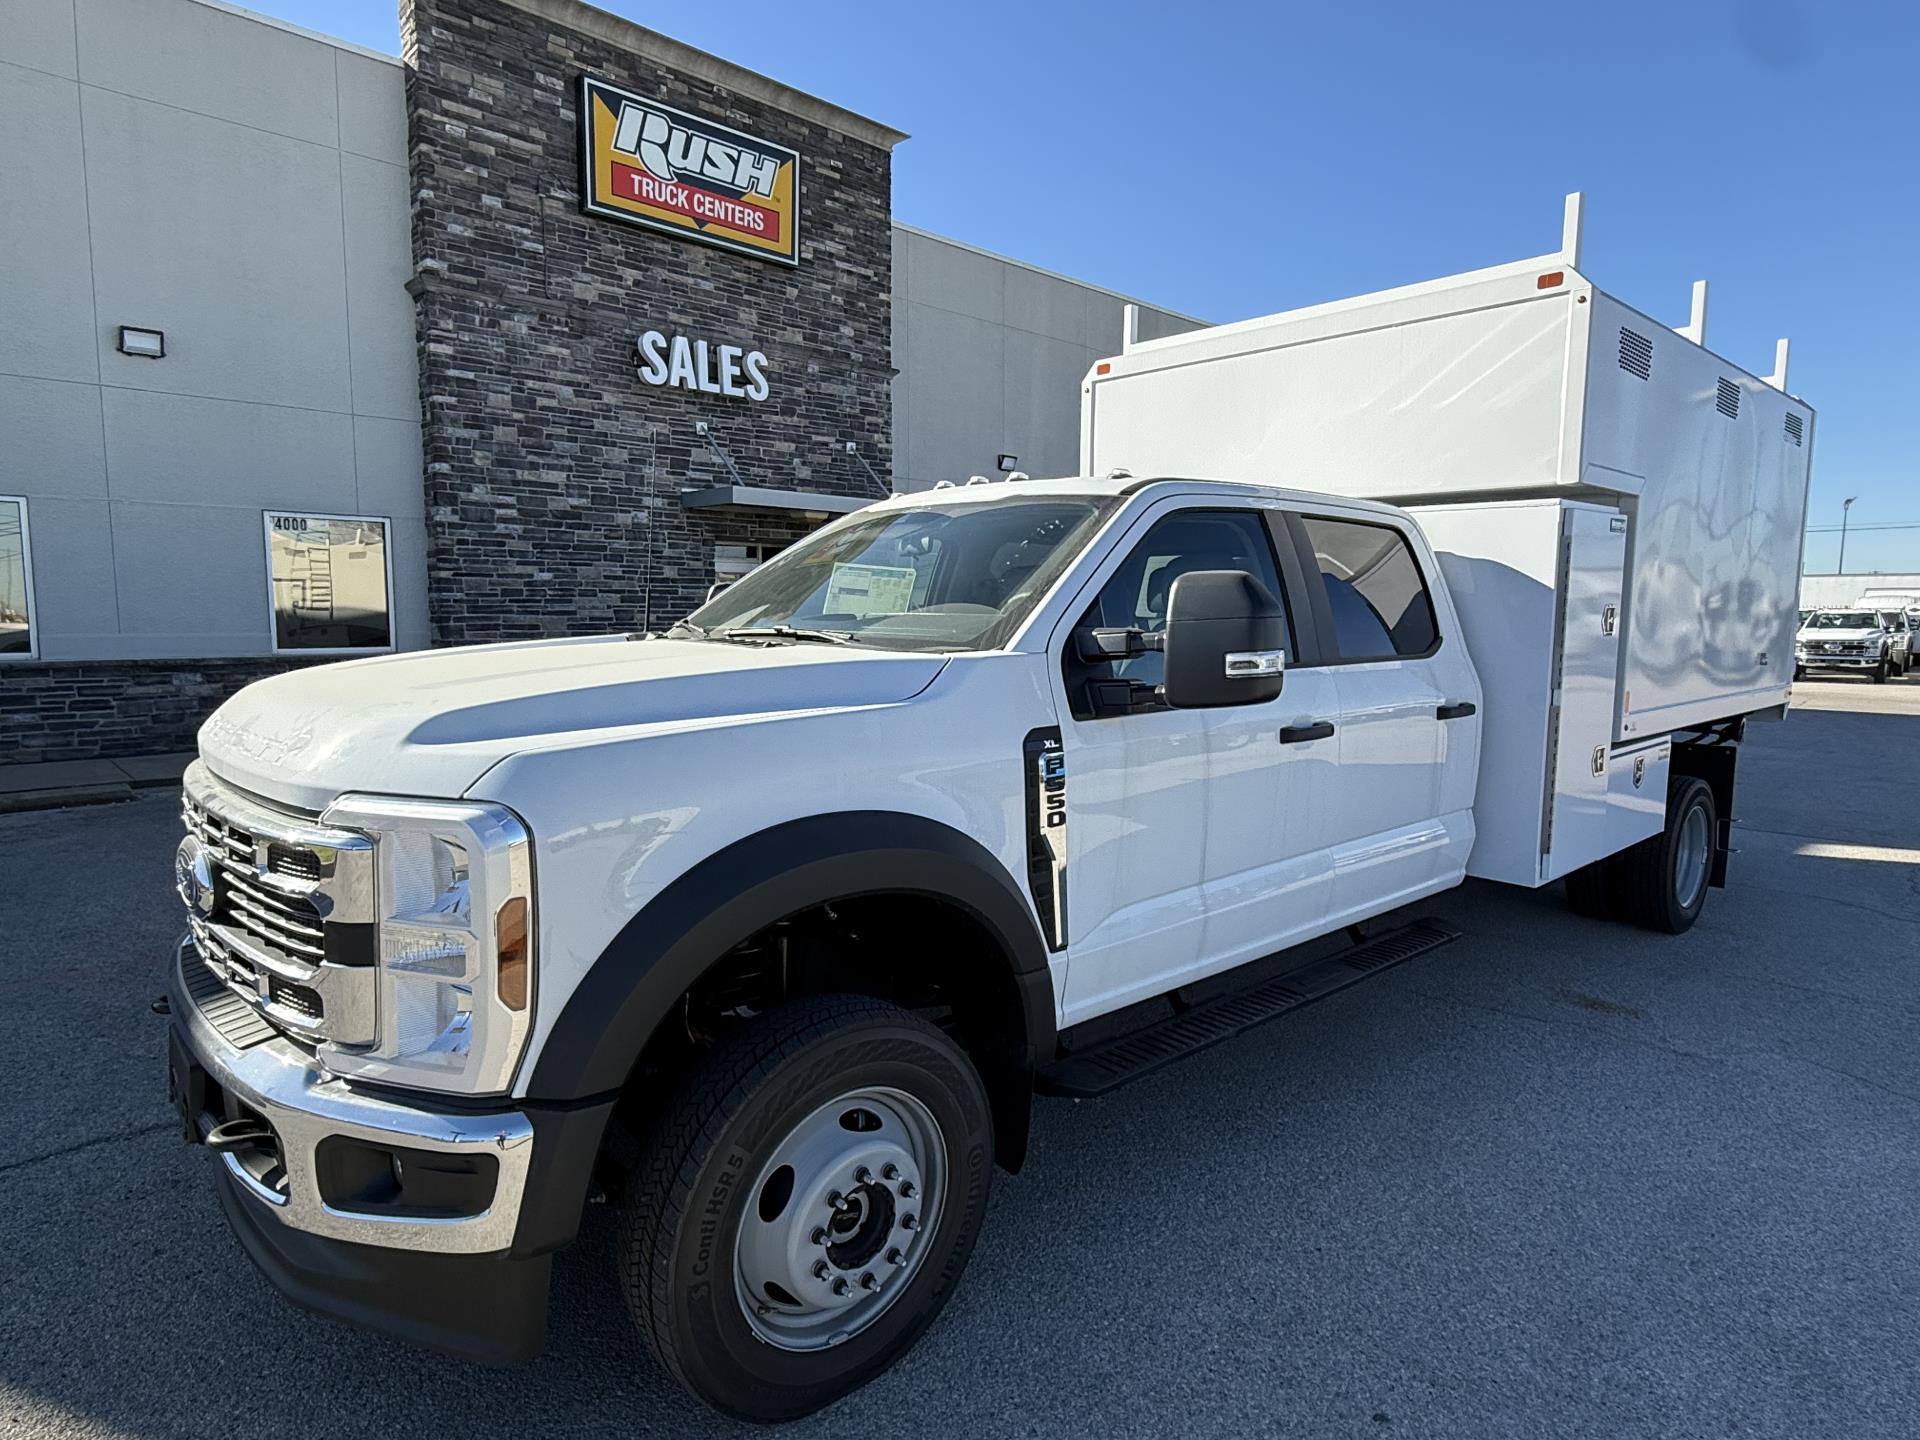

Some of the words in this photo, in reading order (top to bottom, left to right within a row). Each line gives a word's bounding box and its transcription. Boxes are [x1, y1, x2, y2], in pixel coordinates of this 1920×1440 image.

[630, 173, 690, 210] TRUCK
[693, 193, 765, 232] CENTERS
[637, 330, 770, 402] SALES
[274, 517, 307, 531] 4000
[1043, 739, 1060, 749] XL
[692, 1219, 717, 1276] Conti
[705, 1171, 737, 1216] HSR
[727, 1153, 745, 1170] 5
